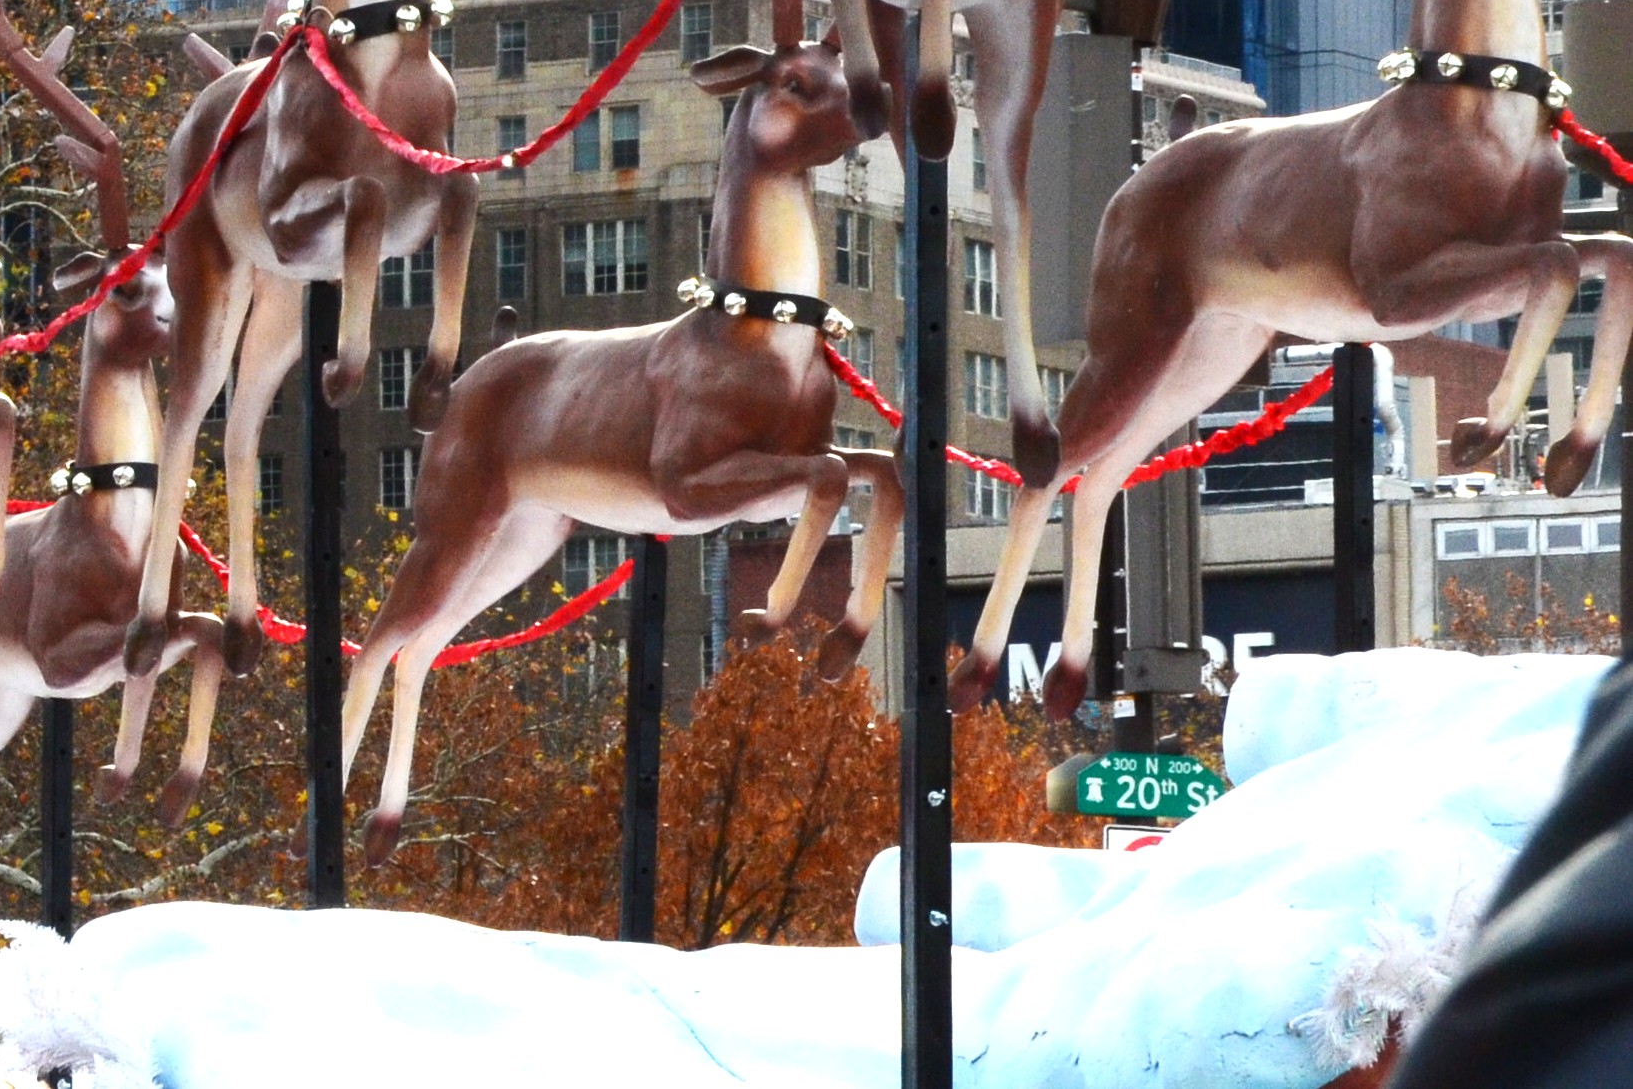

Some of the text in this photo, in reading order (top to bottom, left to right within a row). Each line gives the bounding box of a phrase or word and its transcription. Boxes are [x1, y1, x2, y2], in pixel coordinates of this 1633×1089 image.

[1112, 757, 1192, 775] 300 N 200
[1116, 775, 1220, 813] 20th St
